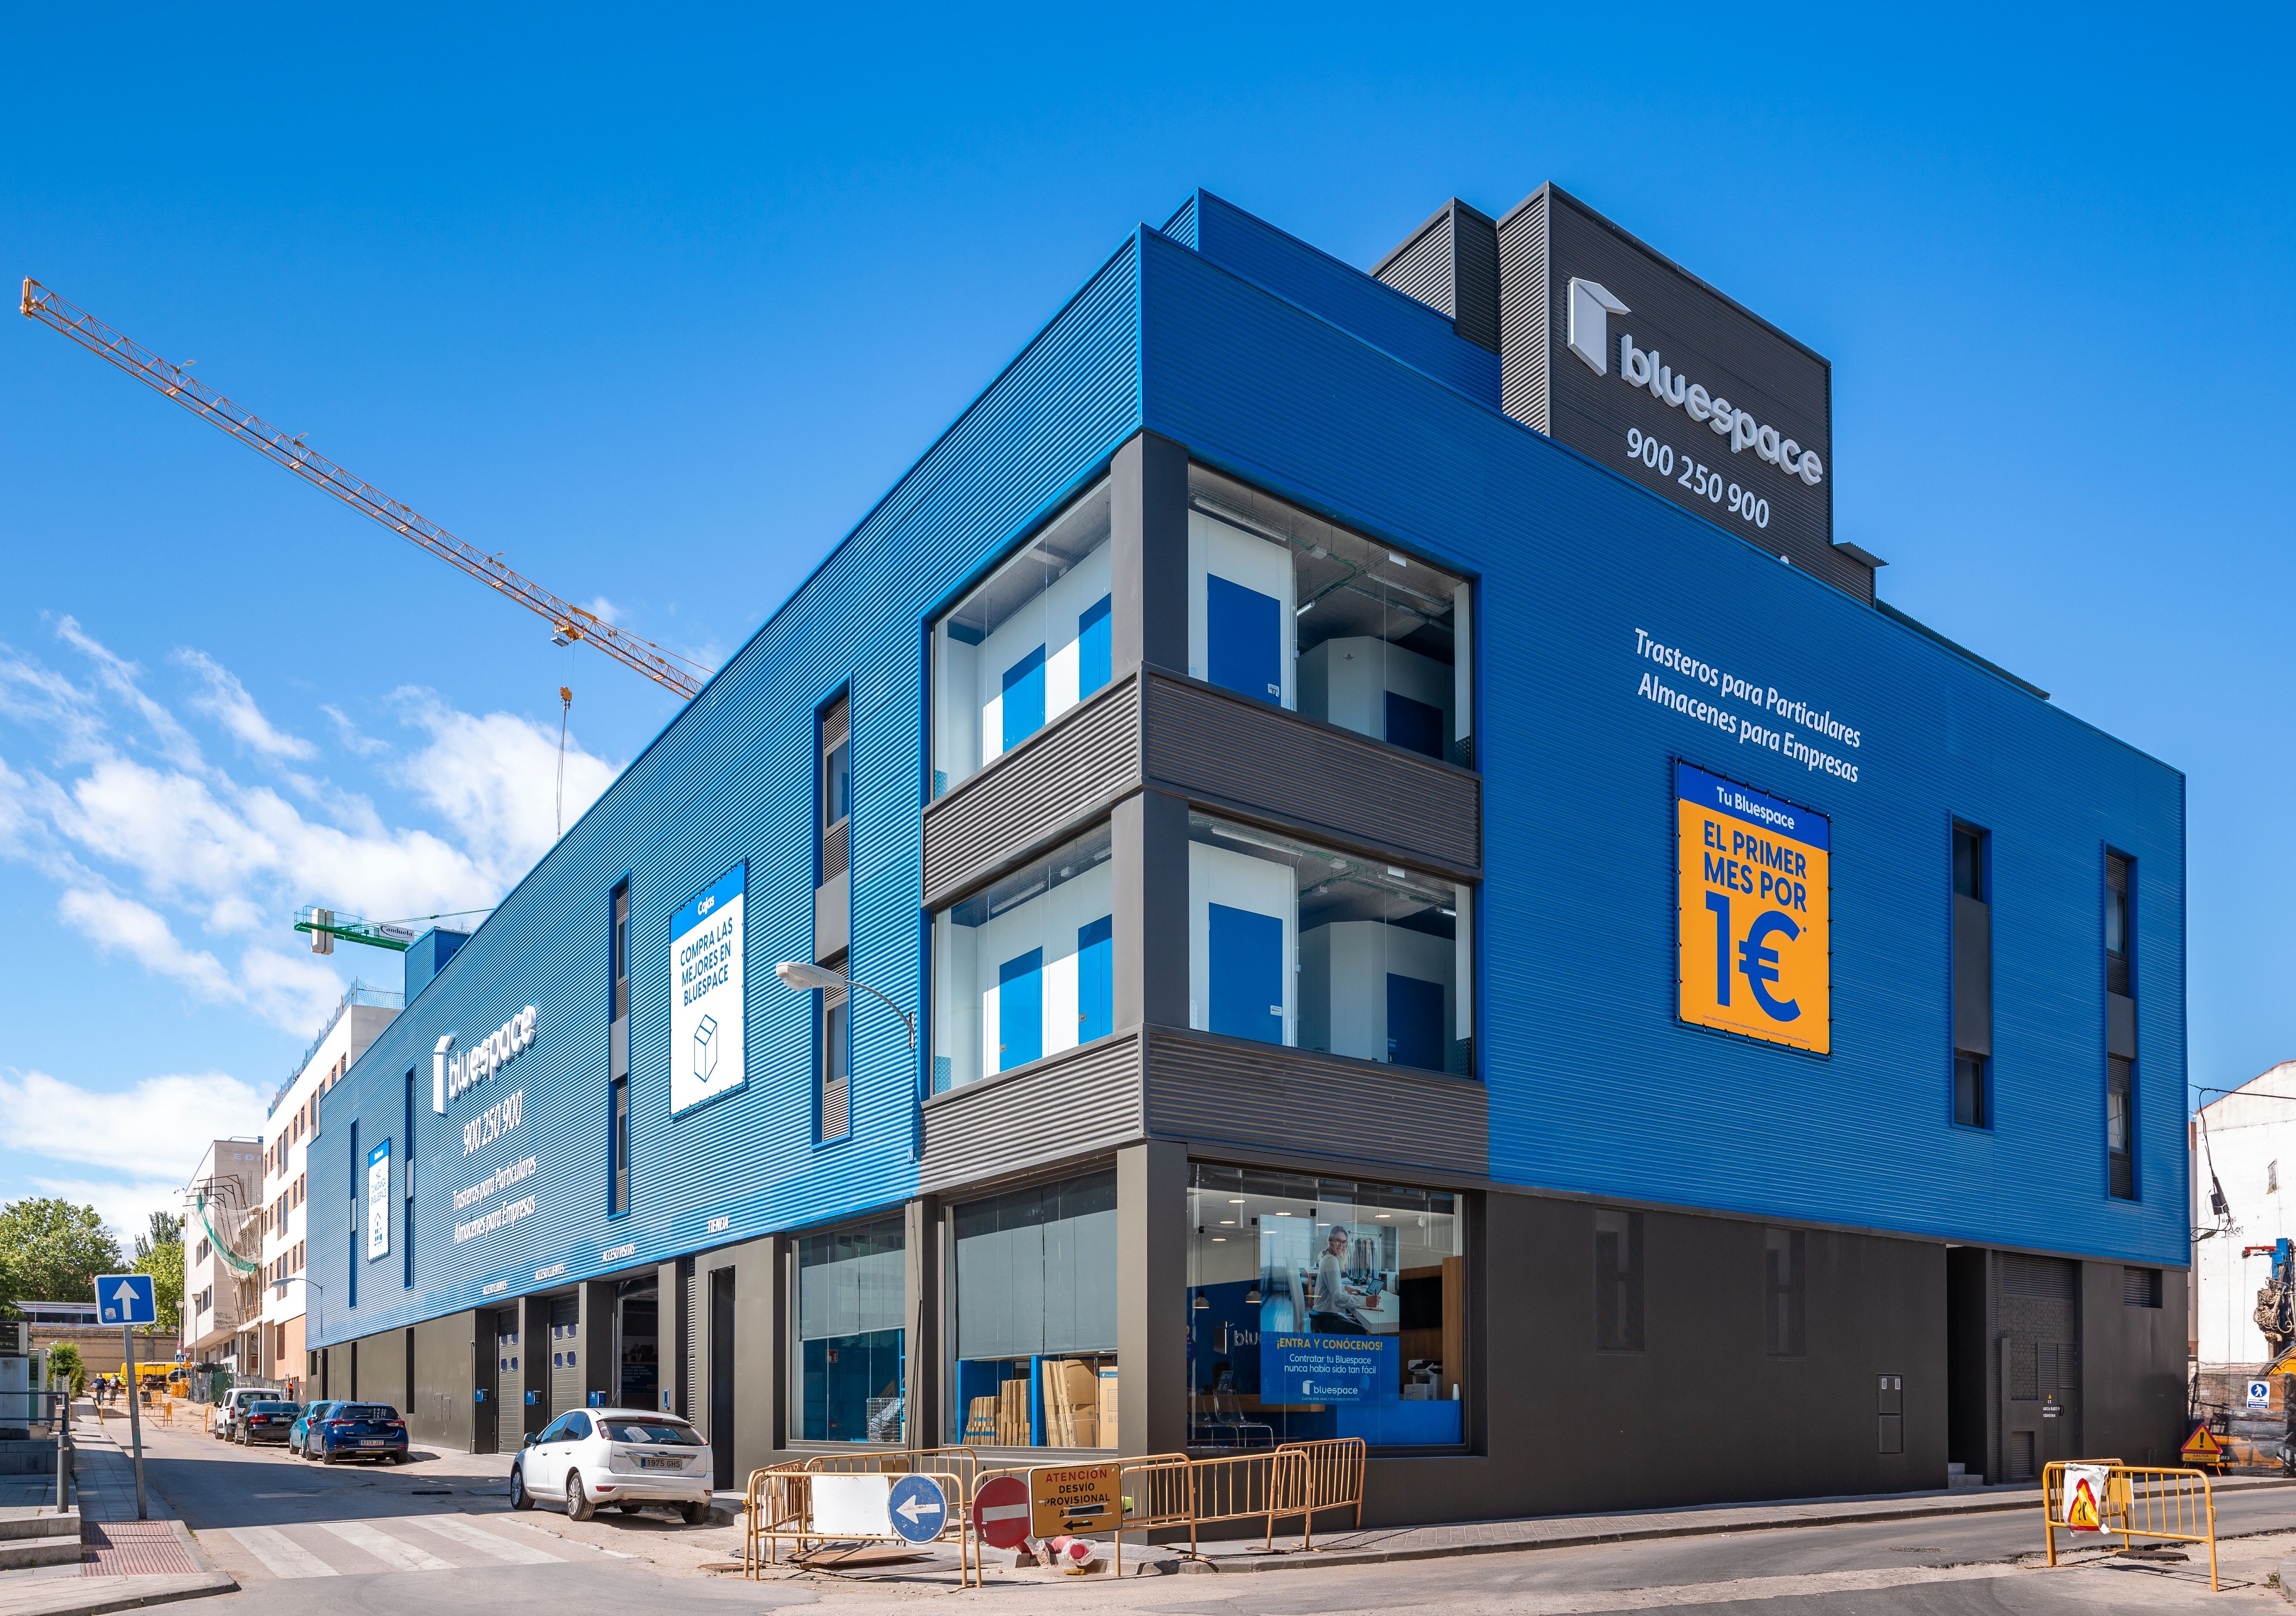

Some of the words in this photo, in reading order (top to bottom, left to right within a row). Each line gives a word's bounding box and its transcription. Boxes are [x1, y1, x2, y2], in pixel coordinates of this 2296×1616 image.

[1621, 334, 1823, 486] bluespace
[1627, 428, 1673, 476] 900
[1678, 456, 1722, 502] 250
[1728, 484, 1769, 528] 900
[1635, 627, 1719, 687] Trasteros
[1721, 673, 1763, 706] para
[1766, 688, 1860, 747] Particulares
[1637, 672, 1736, 734] Almacenes
[1739, 720, 1779, 752] para
[1783, 732, 1859, 783] Empresas
[1717, 786, 1732, 807] Tu
[1735, 793, 1795, 829] Bluespace
[1704, 820, 1727, 852] EL
[1733, 830, 1806, 880] PRIMER
[1704, 852, 1753, 895] MES
[1761, 871, 1807, 912] POR
[698, 896, 714, 915] Cajas
[380, 926, 412, 938] Canduela
[681, 930, 715, 966] COMPRA
[717, 917, 732, 943] LAS
[682, 949, 718, 987] MEJORES
[721, 940, 731, 962] EN
[684, 964, 728, 1007] BLUESPACE
[449, 1005, 537, 1099] bluespace
[464, 1116, 481, 1157] 900
[482, 1103, 501, 1146] 250
[503, 1089, 522, 1135] 900
[453, 1184, 479, 1212] Trasteros
[479, 1176, 495, 1205] para
[495, 1155, 537, 1192] Particulares
[454, 1217, 486, 1245] Almacenes
[486, 1209, 501, 1239] para
[502, 1195, 536, 1228] Empresas
[707, 1215, 729, 1234] TIENDA
[535, 1266, 548, 1281] ACCESO
[548, 1263, 564, 1278] CLIENTES
[602, 1247, 619, 1262] ACCESO
[619, 1242, 636, 1258] VISITAS
[482, 1284, 494, 1295] ACCESO
[493, 1280, 508, 1293] CLIENTES
[1277, 1337, 1311, 1350] ¡ENTRA
[1313, 1339, 1320, 1348] Y
[1323, 1338, 1383, 1350] CONÓCENOS!
[1290, 1354, 1325, 1363] Contratar
[1336, 1356, 1371, 1366] Bluespace
[1309, 1364, 1330, 1373] había
[1314, 1386, 1358, 1396] bluespace
[1044, 1493, 1110, 1507] PROVISIONAL
[1059, 1482, 1095, 1494] DESVÍO
[1059, 1510, 1065, 1518] A
